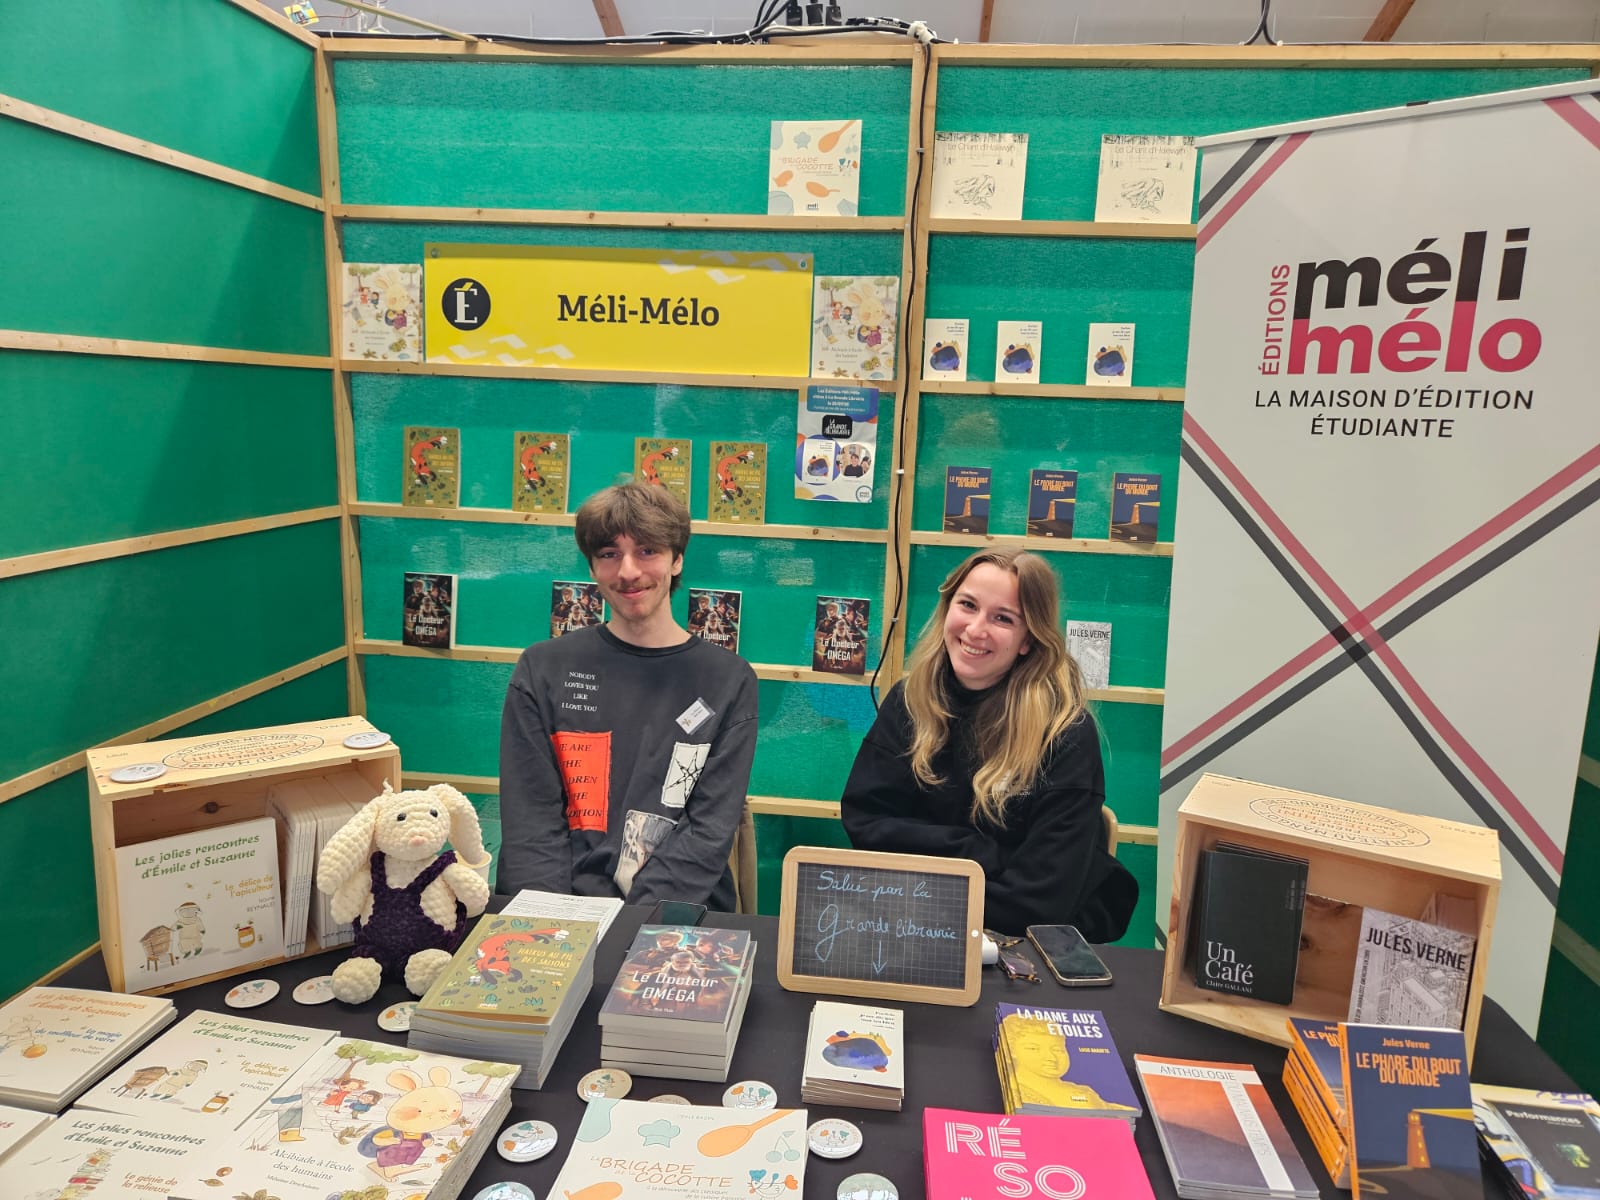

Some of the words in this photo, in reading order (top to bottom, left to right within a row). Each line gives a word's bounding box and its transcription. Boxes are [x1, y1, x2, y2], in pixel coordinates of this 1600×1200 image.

[1293, 227, 1530, 315] méli
[557, 294, 719, 326] Méli-Mélo
[1258, 264, 1291, 375] ÉDITIONS
[1287, 303, 1542, 375] mélo
[1255, 390, 1282, 407] LA
[1289, 389, 1386, 407] MAISON
[1394, 385, 1534, 410] D'ÉDITION
[1310, 413, 1454, 437] ÉTUDIANTE
[415, 624, 437, 636] OMÉGA
[1069, 628, 1089, 638] JULES
[1090, 630, 1111, 639] VERNE
[827, 649, 851, 661] OMÉGA
[569, 671, 596, 681] NOBODY
[564, 681, 585, 690] LOVES
[585, 683, 600, 692] YOU
[573, 692, 588, 701] LIKE
[566, 703, 582, 711] LOVE
[570, 743, 592, 752] ARE
[134, 855, 155, 867] Les
[159, 850, 191, 864] jolies
[195, 834, 260, 854] rencontres
[141, 864, 186, 879] d'Émile
[190, 860, 201, 870] et
[204, 849, 256, 866] Suzanne
[225, 883, 234, 892] Le
[238, 877, 262, 889] délice
[263, 874, 273, 883] de
[230, 883, 274, 898] l'apiculteur
[817, 870, 867, 893] Salué
[871, 886, 904, 902] par
[912, 881, 932, 898] la
[815, 903, 890, 962] Grande
[1206, 940, 1236, 964] Un
[1366, 928, 1413, 955] JULES
[1416, 942, 1468, 971] VERNE
[632, 971, 650, 983] Le
[656, 973, 719, 988] Docteur
[1205, 959, 1254, 985] Café
[642, 987, 696, 1003] OMÉGA
[1016, 1008, 1032, 1021] LA
[1035, 1010, 1070, 1024] DAME
[1073, 1013, 1099, 1025] AUX
[193, 1028, 233, 1041] d'Émile
[235, 1034, 244, 1042] et
[246, 1035, 296, 1051] Suzanne
[198, 1019, 217, 1027] Les
[219, 1021, 247, 1034] jolies
[250, 1026, 311, 1042] rencontres
[1047, 1023, 1104, 1039] ETOILES
[1303, 1030, 1319, 1040] LE
[1382, 1038, 1404, 1048] Jules
[1405, 1039, 1430, 1050] Verne
[1160, 1065, 1237, 1081] ANTHOLOGIE
[1355, 1052, 1370, 1069] LE
[1372, 1053, 1409, 1071] PHARE
[1411, 1056, 1428, 1074] DU
[1430, 1058, 1462, 1076] BOUT
[1379, 1067, 1396, 1084] DU
[1396, 1069, 1440, 1087] MONDE
[72, 1120, 93, 1129] Les
[97, 1123, 132, 1135] jolies
[133, 1128, 207, 1145] rencontres
[944, 1118, 1027, 1160] RÉ
[64, 1131, 110, 1147] d'Émile
[113, 1139, 127, 1147] et
[128, 1140, 188, 1157] Suzanne
[270, 1147, 316, 1167] Alcibiade
[317, 1159, 324, 1167] à
[325, 1158, 355, 1174] l'école
[599, 1157, 696, 1175] BRIGADE
[124, 1172, 136, 1180] Le
[135, 1174, 163, 1183] génie
[165, 1177, 178, 1186] de
[273, 1161, 290, 1173] des
[291, 1165, 333, 1181] humains
[635, 1172, 734, 1188] COCOTTE
[993, 1162, 1087, 1200] SO
[121, 1180, 132, 1188] la
[133, 1183, 171, 1194] relieuse
